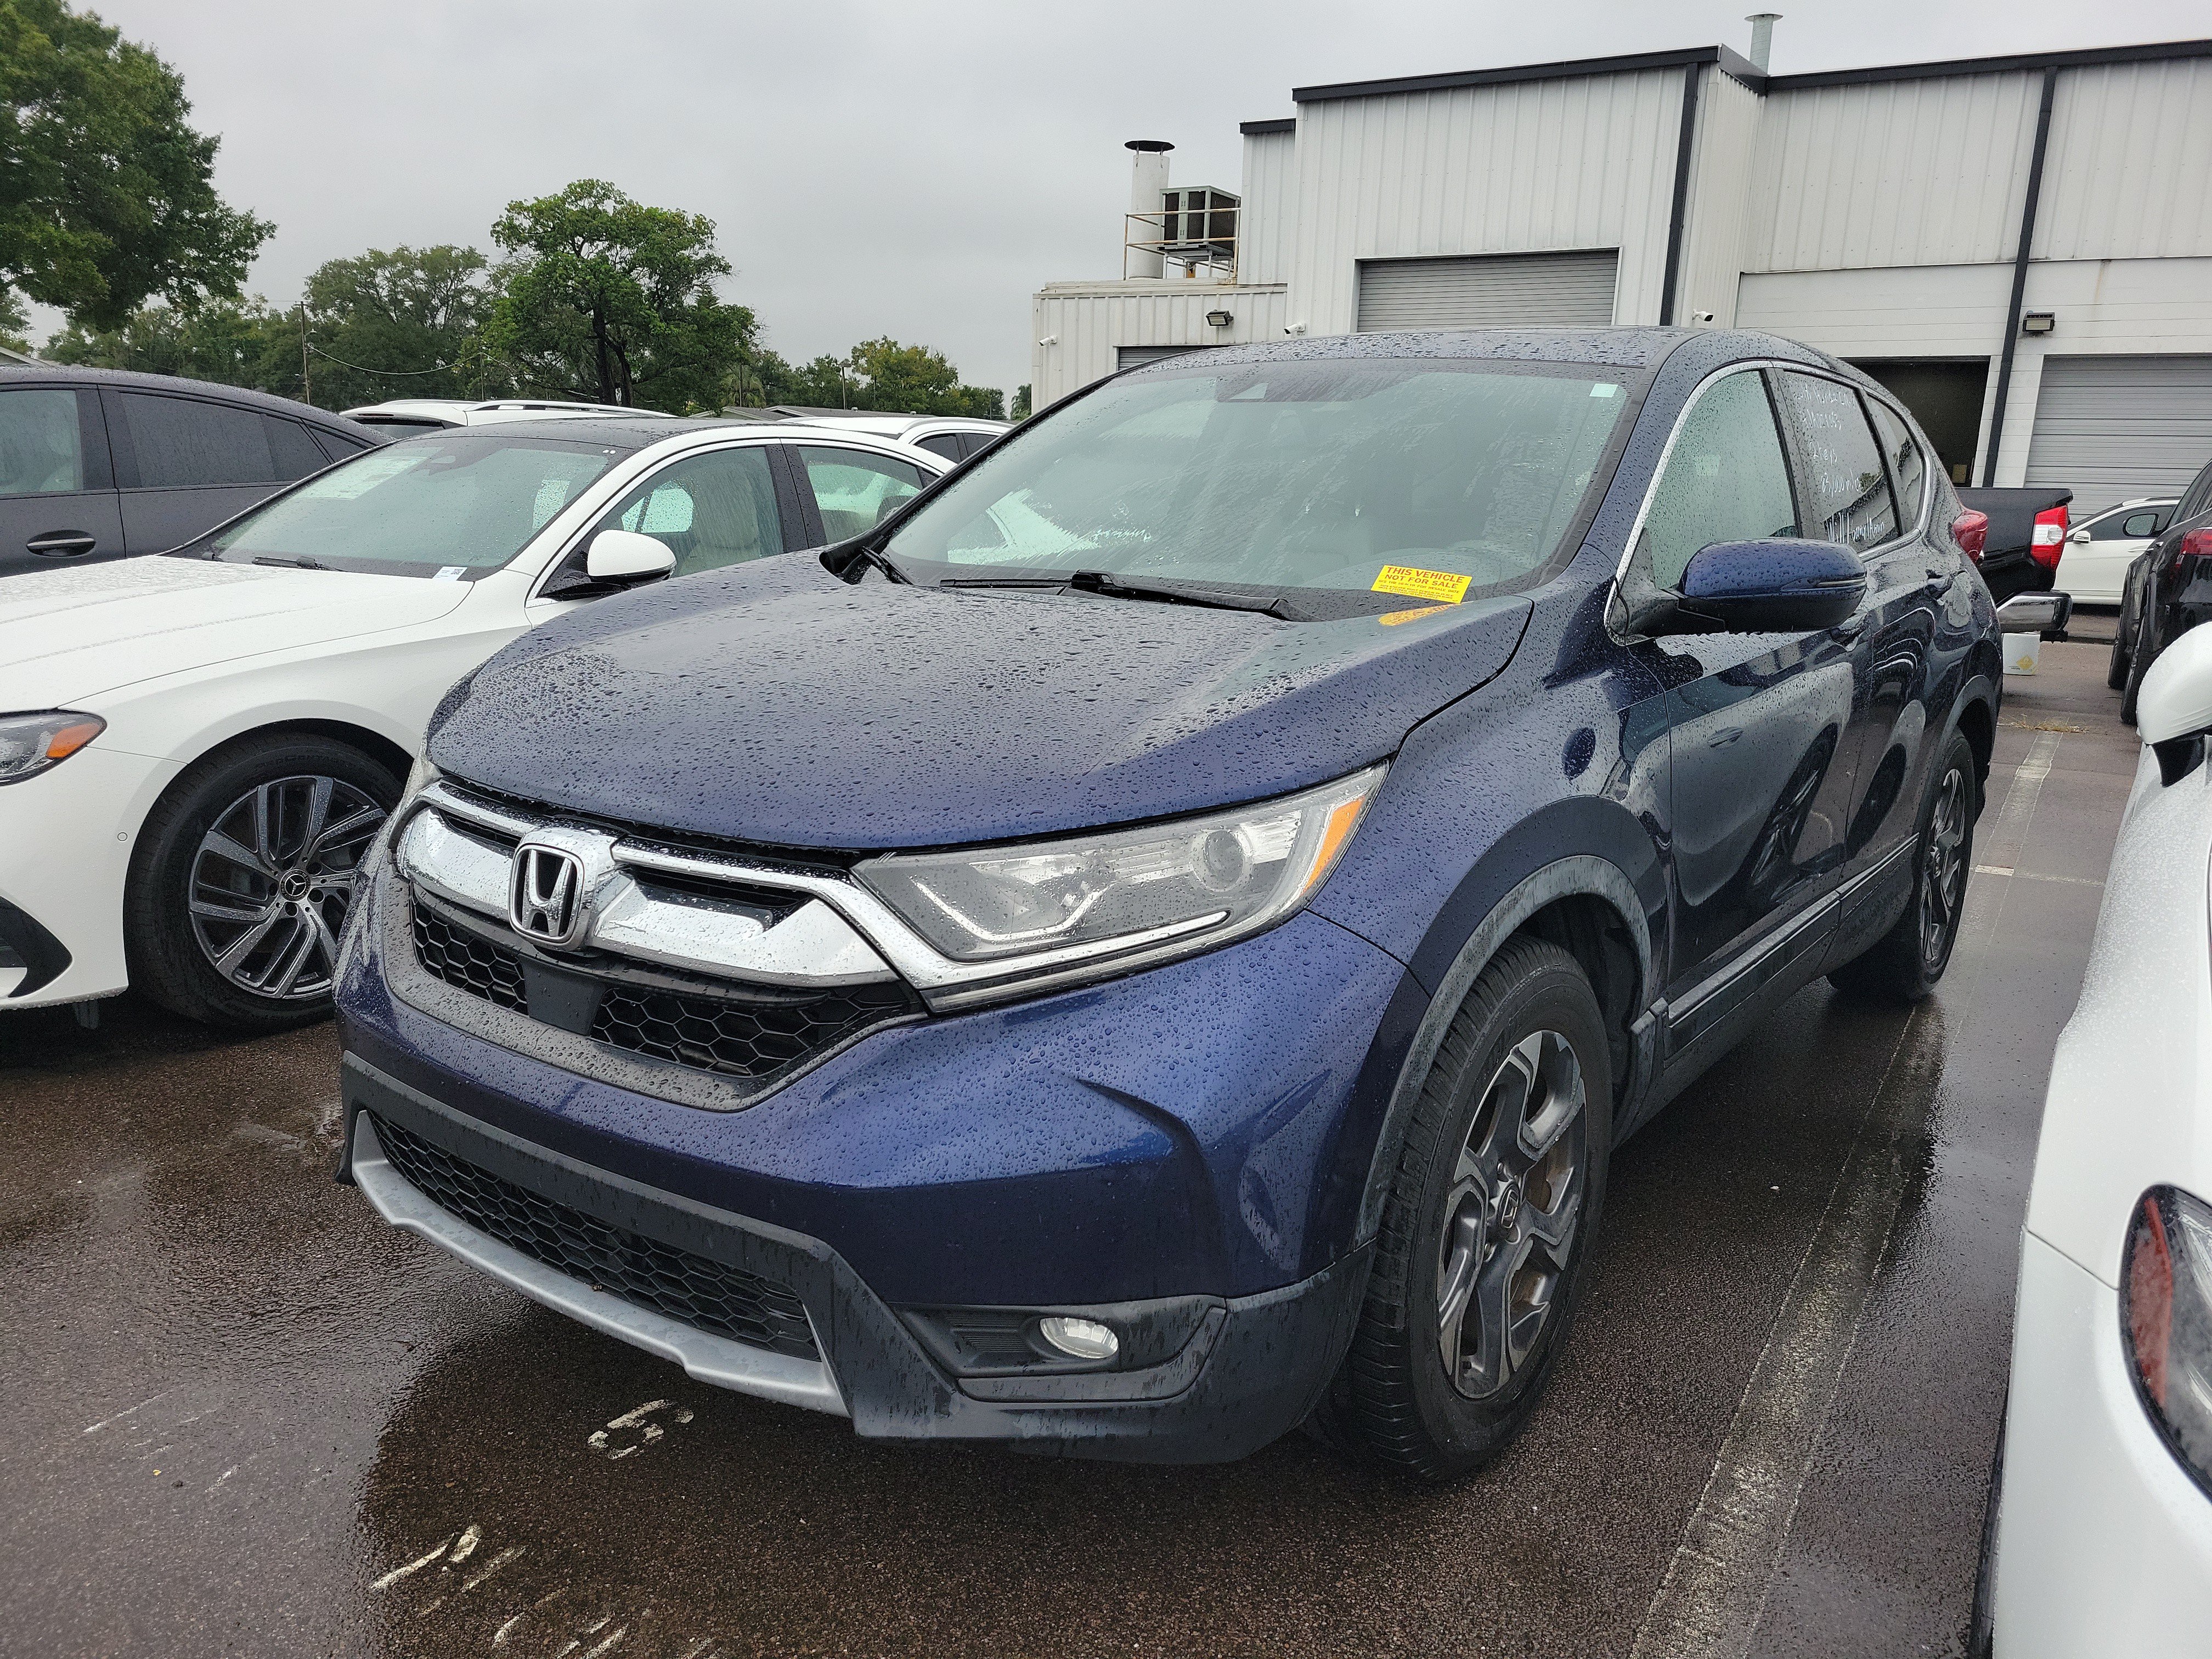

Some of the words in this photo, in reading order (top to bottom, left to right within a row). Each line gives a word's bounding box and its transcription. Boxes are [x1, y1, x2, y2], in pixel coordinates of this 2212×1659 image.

[1387, 567, 1412, 575] THIS
[1416, 570, 1465, 583] VEHICLE
[1431, 580, 1459, 589] SALE
